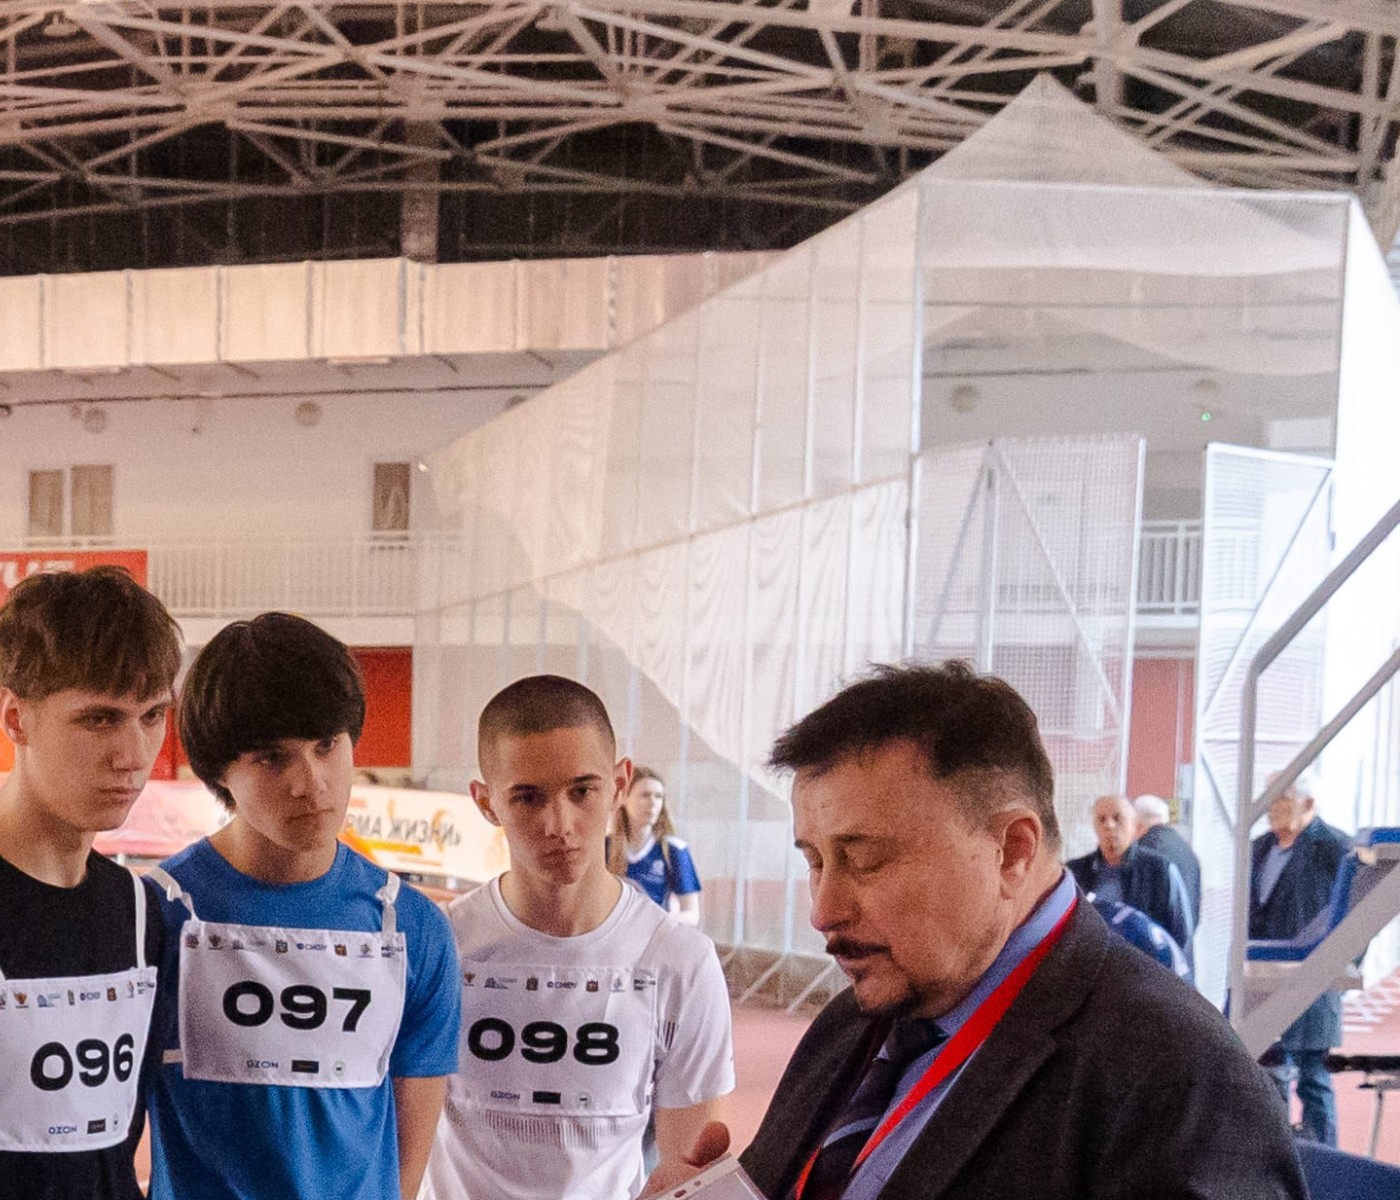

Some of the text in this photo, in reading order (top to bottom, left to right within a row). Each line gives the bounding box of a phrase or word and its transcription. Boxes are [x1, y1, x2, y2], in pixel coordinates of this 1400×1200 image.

[222, 980, 372, 1033] 097
[30, 1033, 134, 1091] 096
[246, 1059, 279, 1070] OZON
[468, 1017, 620, 1066] 098
[47, 1125, 78, 1136] OZON
